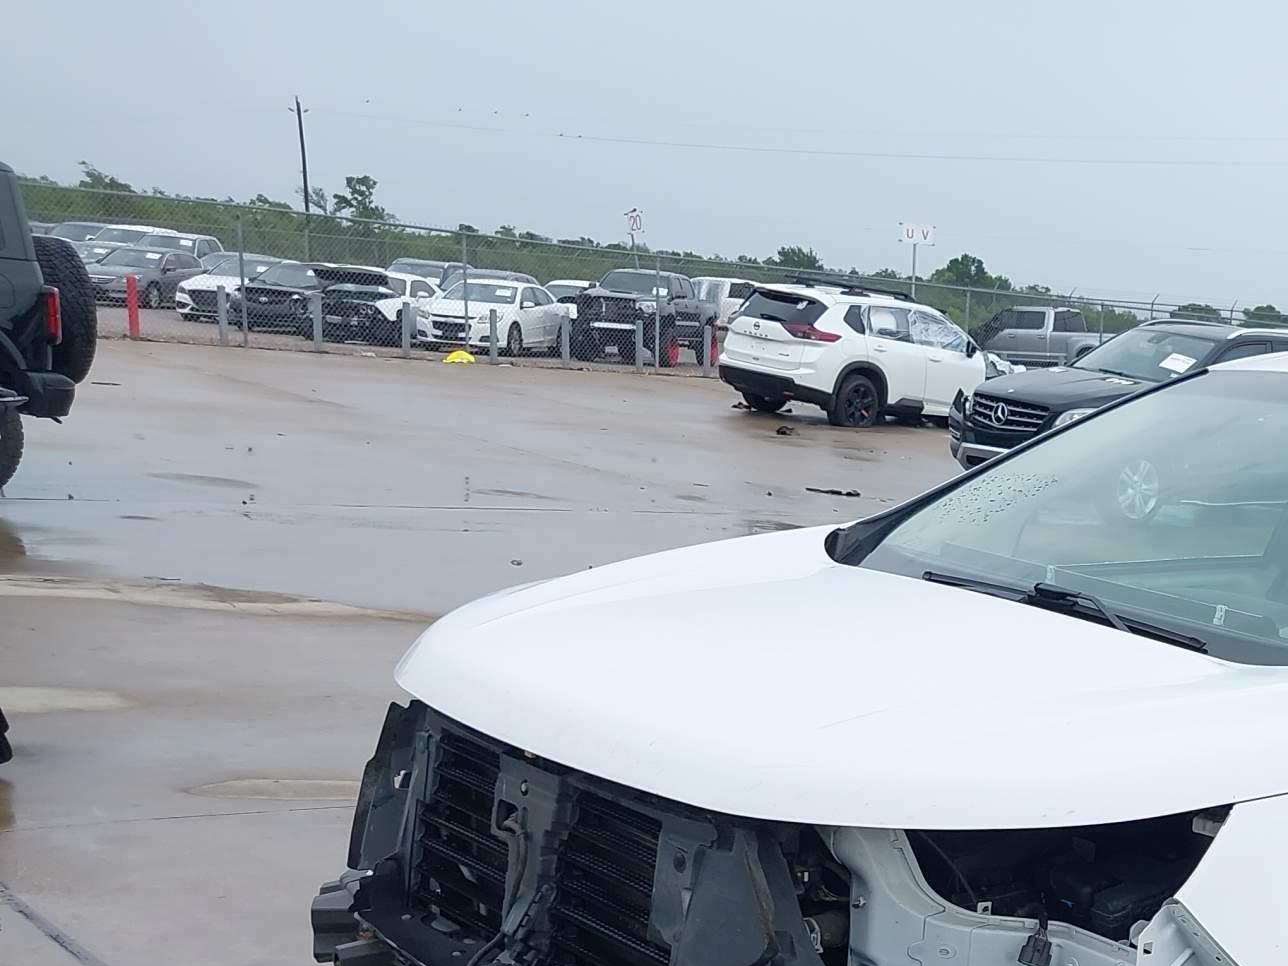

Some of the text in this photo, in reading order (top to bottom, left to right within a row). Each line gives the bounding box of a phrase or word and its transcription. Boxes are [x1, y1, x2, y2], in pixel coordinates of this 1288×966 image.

[629, 214, 642, 231] 20
[906, 228, 930, 241] U V
